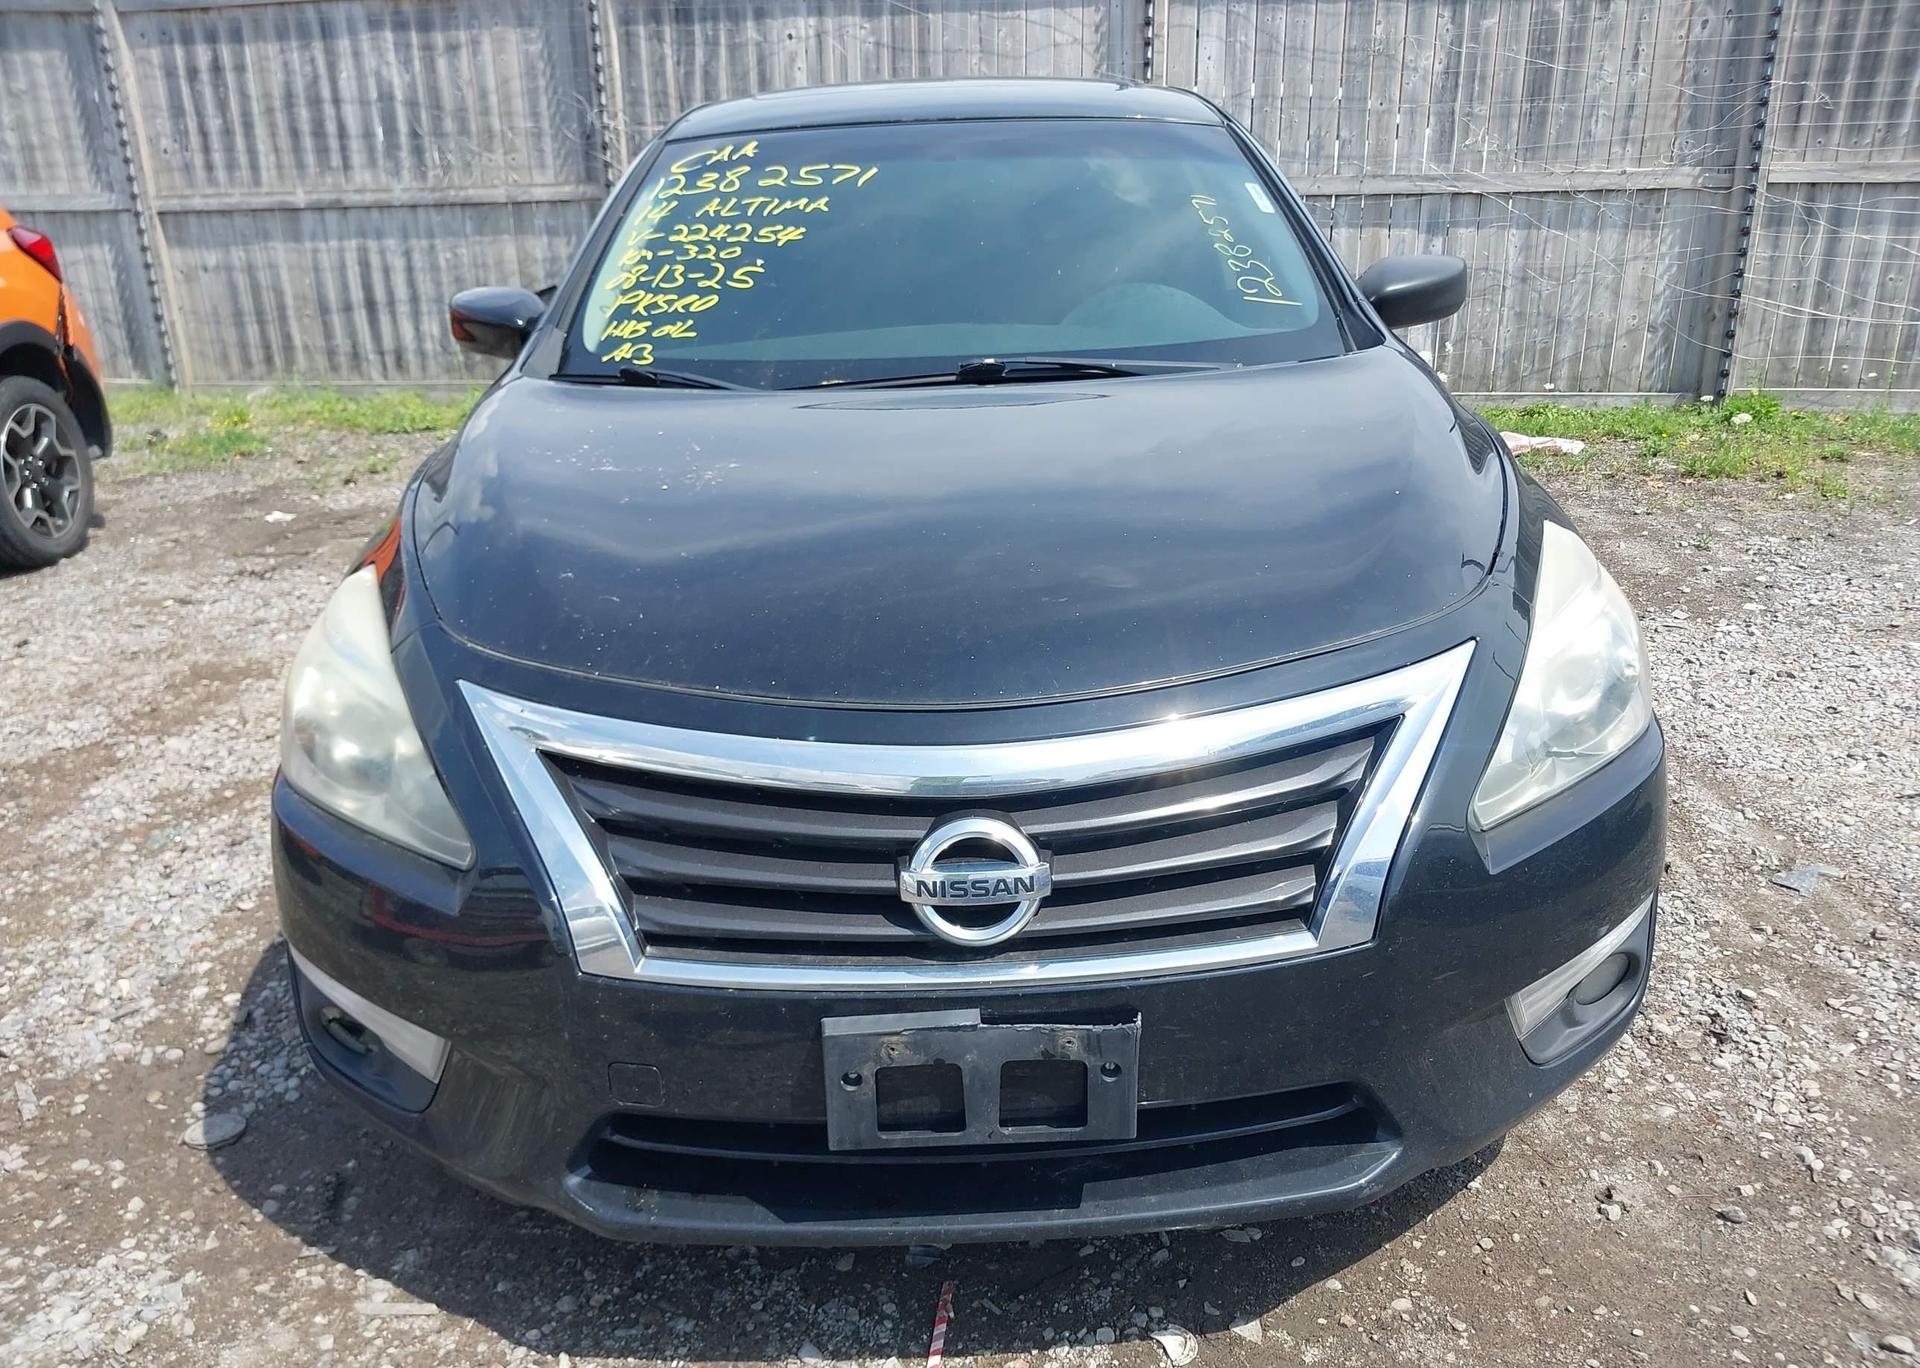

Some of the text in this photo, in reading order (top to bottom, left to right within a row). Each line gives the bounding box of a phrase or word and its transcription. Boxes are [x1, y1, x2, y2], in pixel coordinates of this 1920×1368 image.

[670, 140, 759, 174] CAA
[695, 196, 830, 218] ALTIMA
[916, 875, 1035, 898] NISSAN
